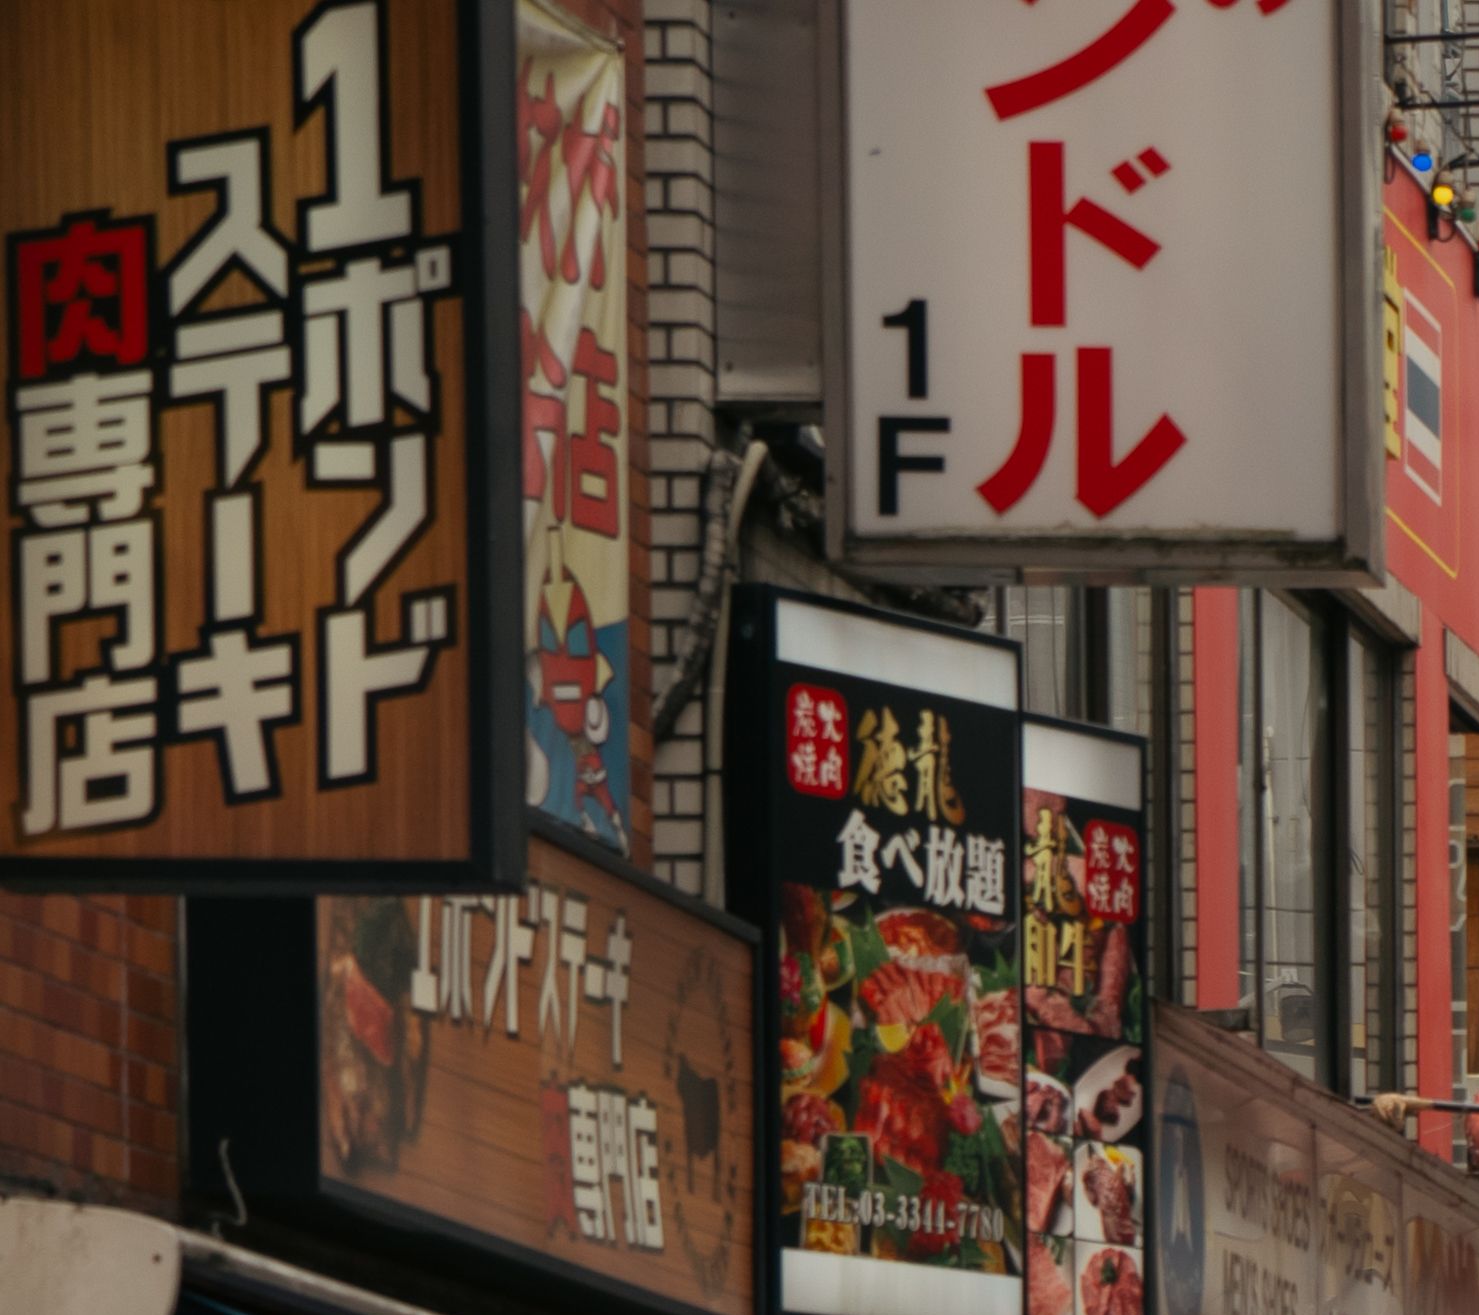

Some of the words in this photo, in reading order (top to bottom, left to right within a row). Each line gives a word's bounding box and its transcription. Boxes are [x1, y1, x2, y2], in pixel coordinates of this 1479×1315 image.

[14, 222, 158, 838] 肉専門店
[165, 135, 295, 797] ステーキ
[293, 0, 455, 782] 1ポンド
[877, 299, 951, 516] 1F
[836, 809, 1006, 914] 食べ放題
